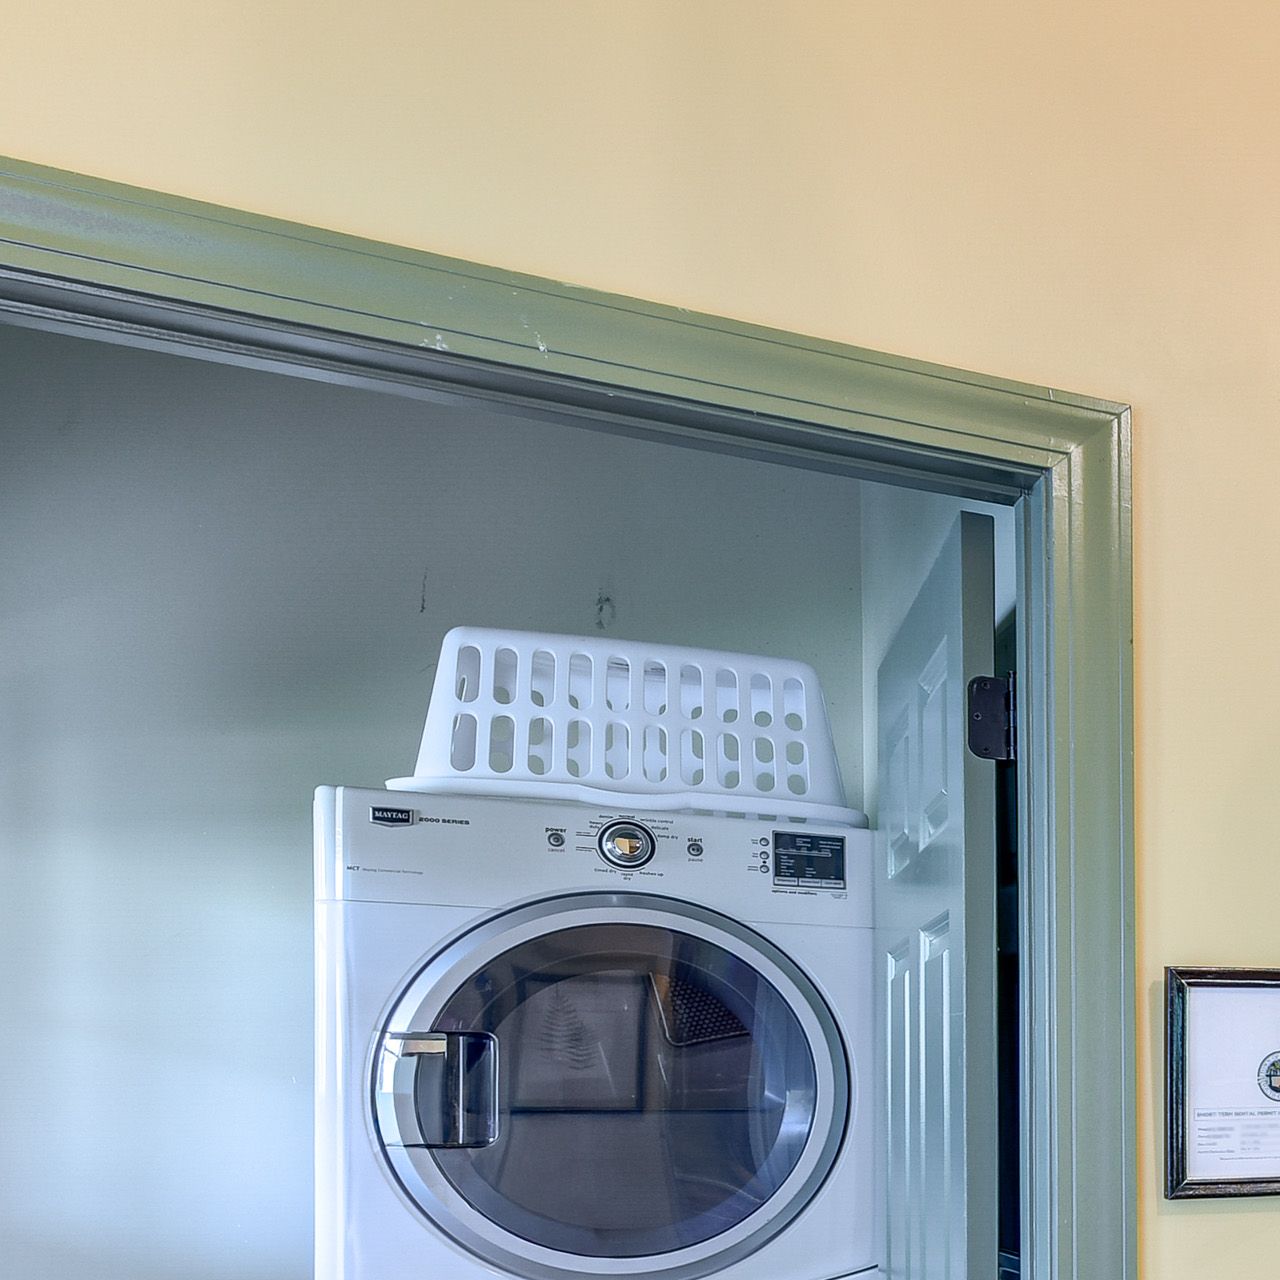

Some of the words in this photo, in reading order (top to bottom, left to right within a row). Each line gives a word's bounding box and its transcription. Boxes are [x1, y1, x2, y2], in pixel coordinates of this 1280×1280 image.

[374, 810, 409, 820] MAYTAG
[418, 816, 441, 824] 2000
[441, 818, 470, 826] SERIES
